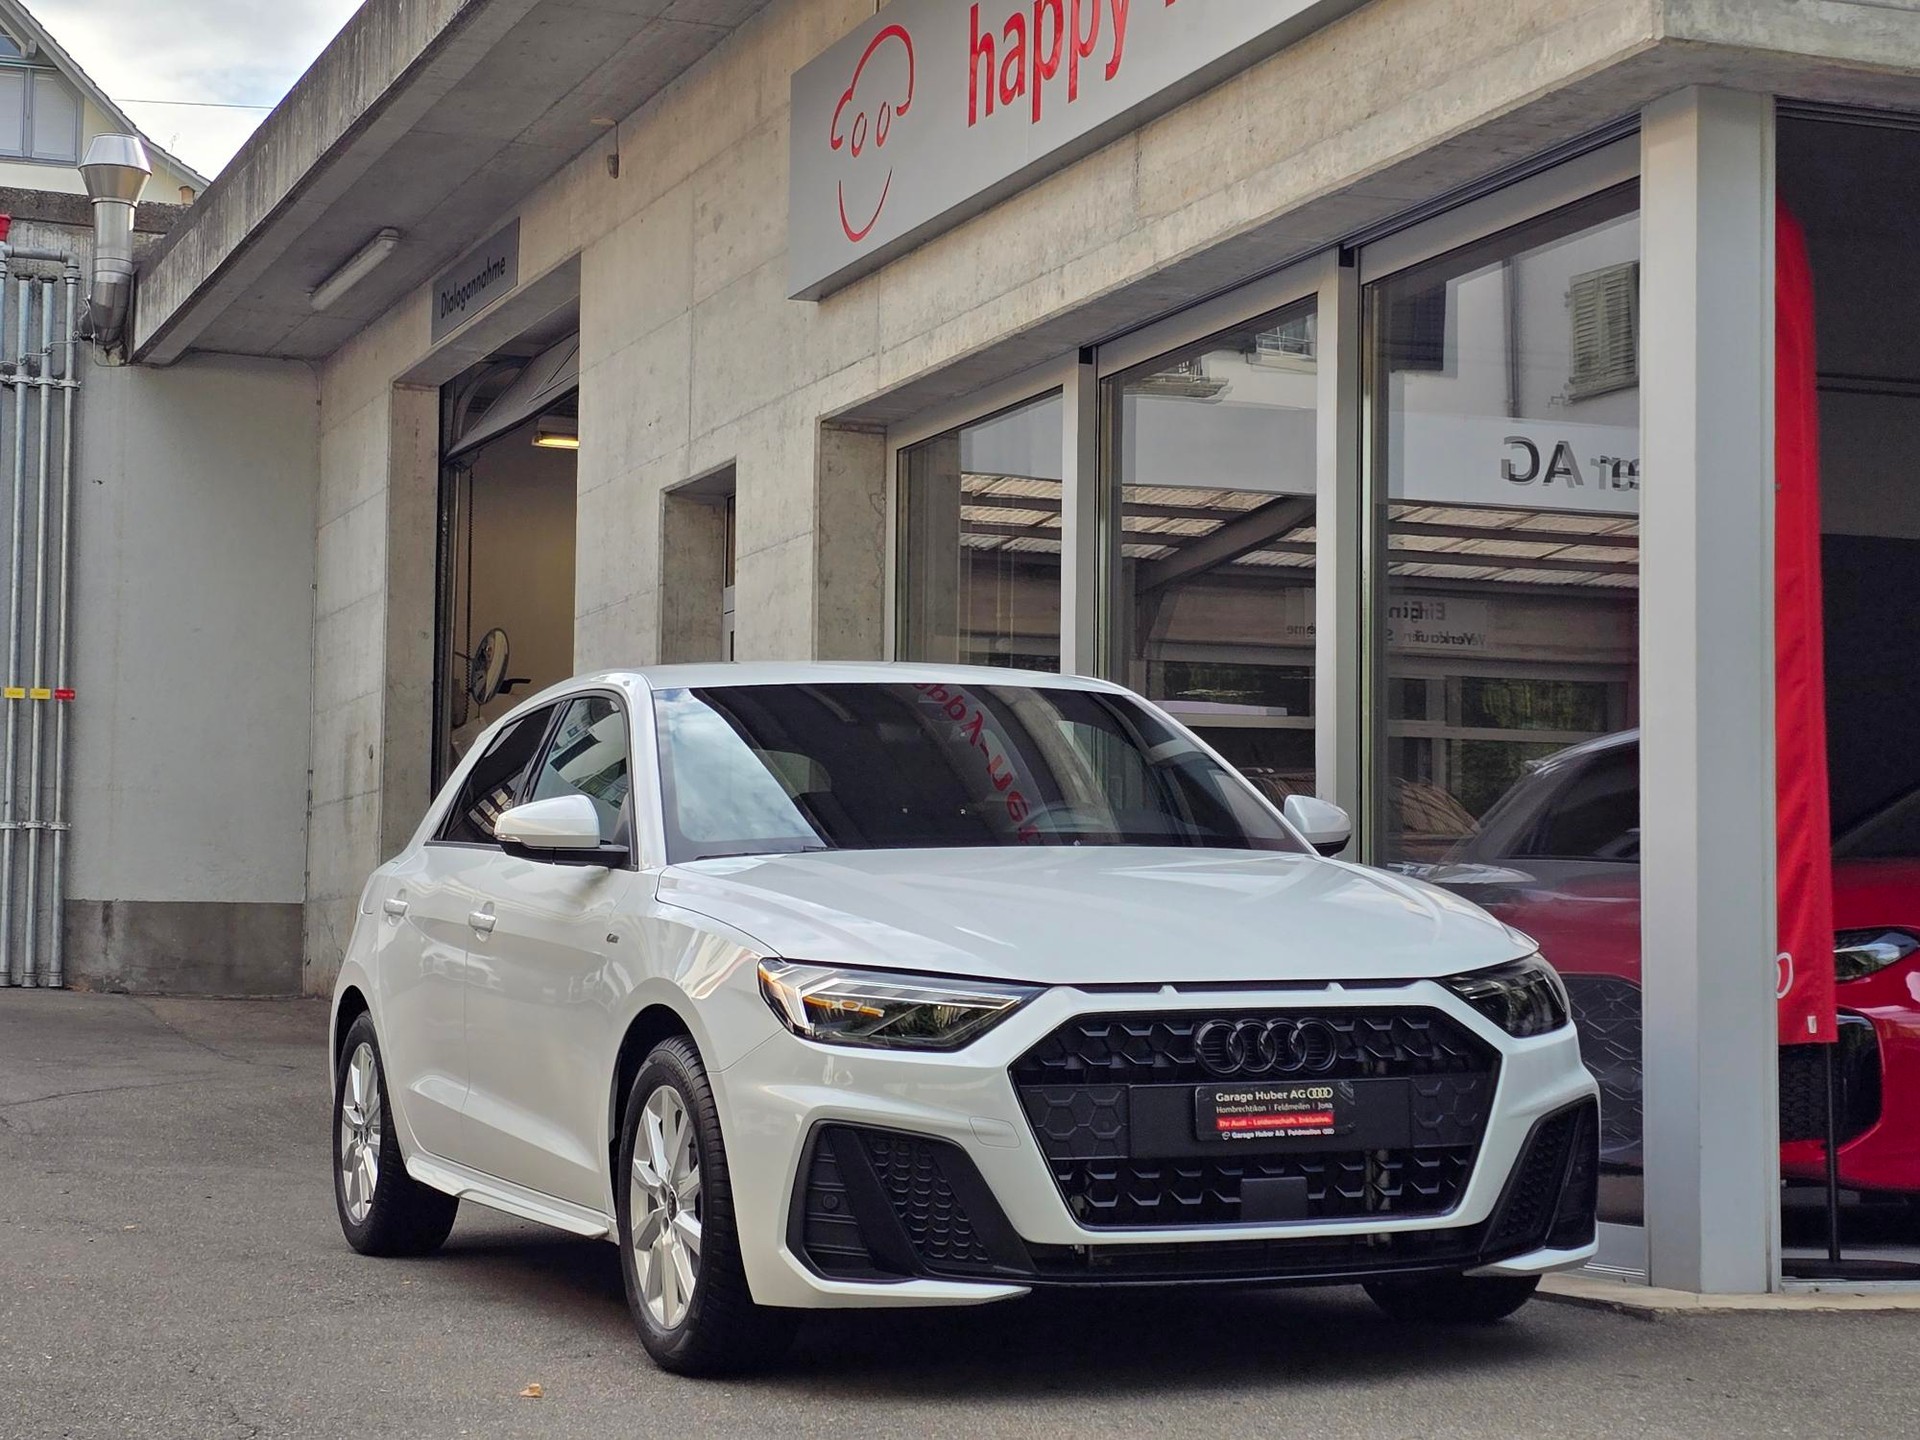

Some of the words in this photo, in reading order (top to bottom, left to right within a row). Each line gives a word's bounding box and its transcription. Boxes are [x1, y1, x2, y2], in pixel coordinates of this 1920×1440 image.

[968, 0, 1130, 128] happy
[440, 256, 506, 319] Dialogannahme
[1215, 1093, 1253, 1103] Garage
[1256, 1091, 1288, 1100] Huber
[1290, 1090, 1306, 1099] AG
[1274, 1102, 1311, 1112] Feldmeilen
